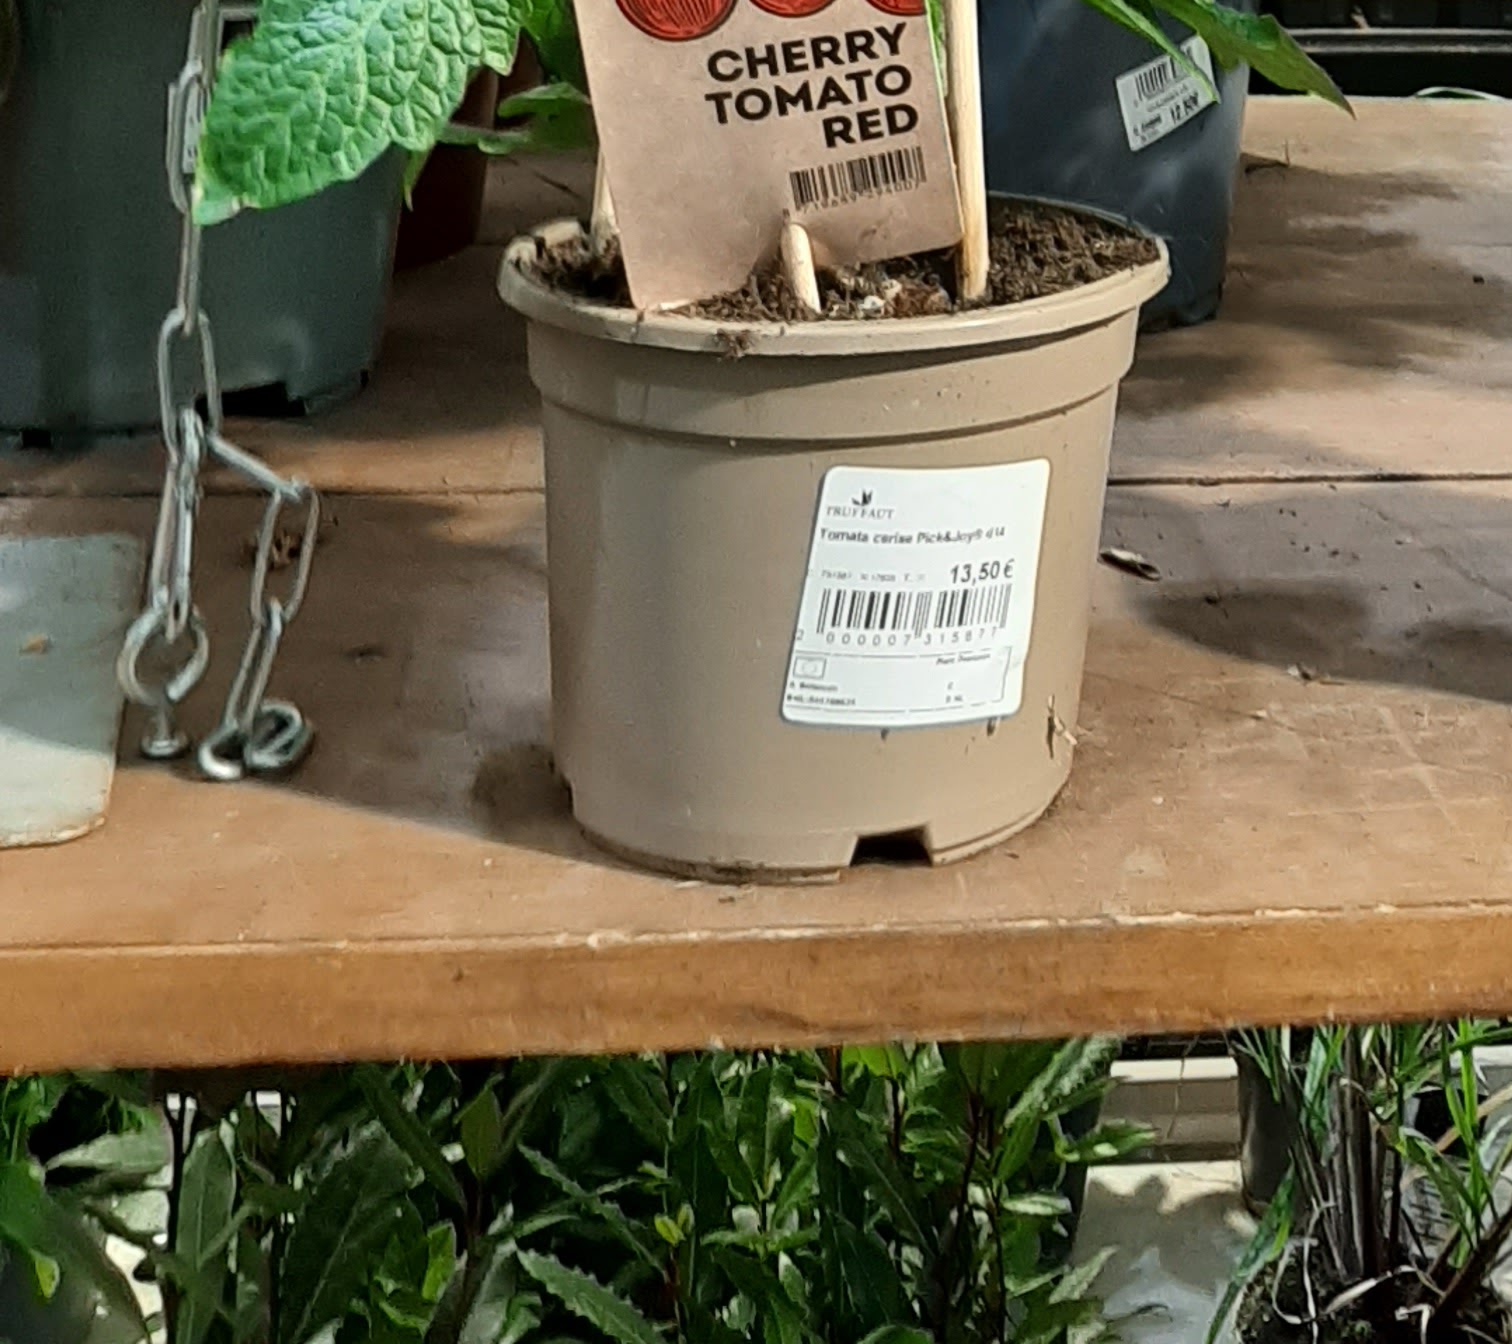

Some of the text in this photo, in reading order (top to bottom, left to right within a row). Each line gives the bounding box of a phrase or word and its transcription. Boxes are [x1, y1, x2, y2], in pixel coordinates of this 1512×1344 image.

[707, 21, 907, 82] CHERRY
[705, 64, 912, 124] TOMATO
[822, 103, 919, 148] RED
